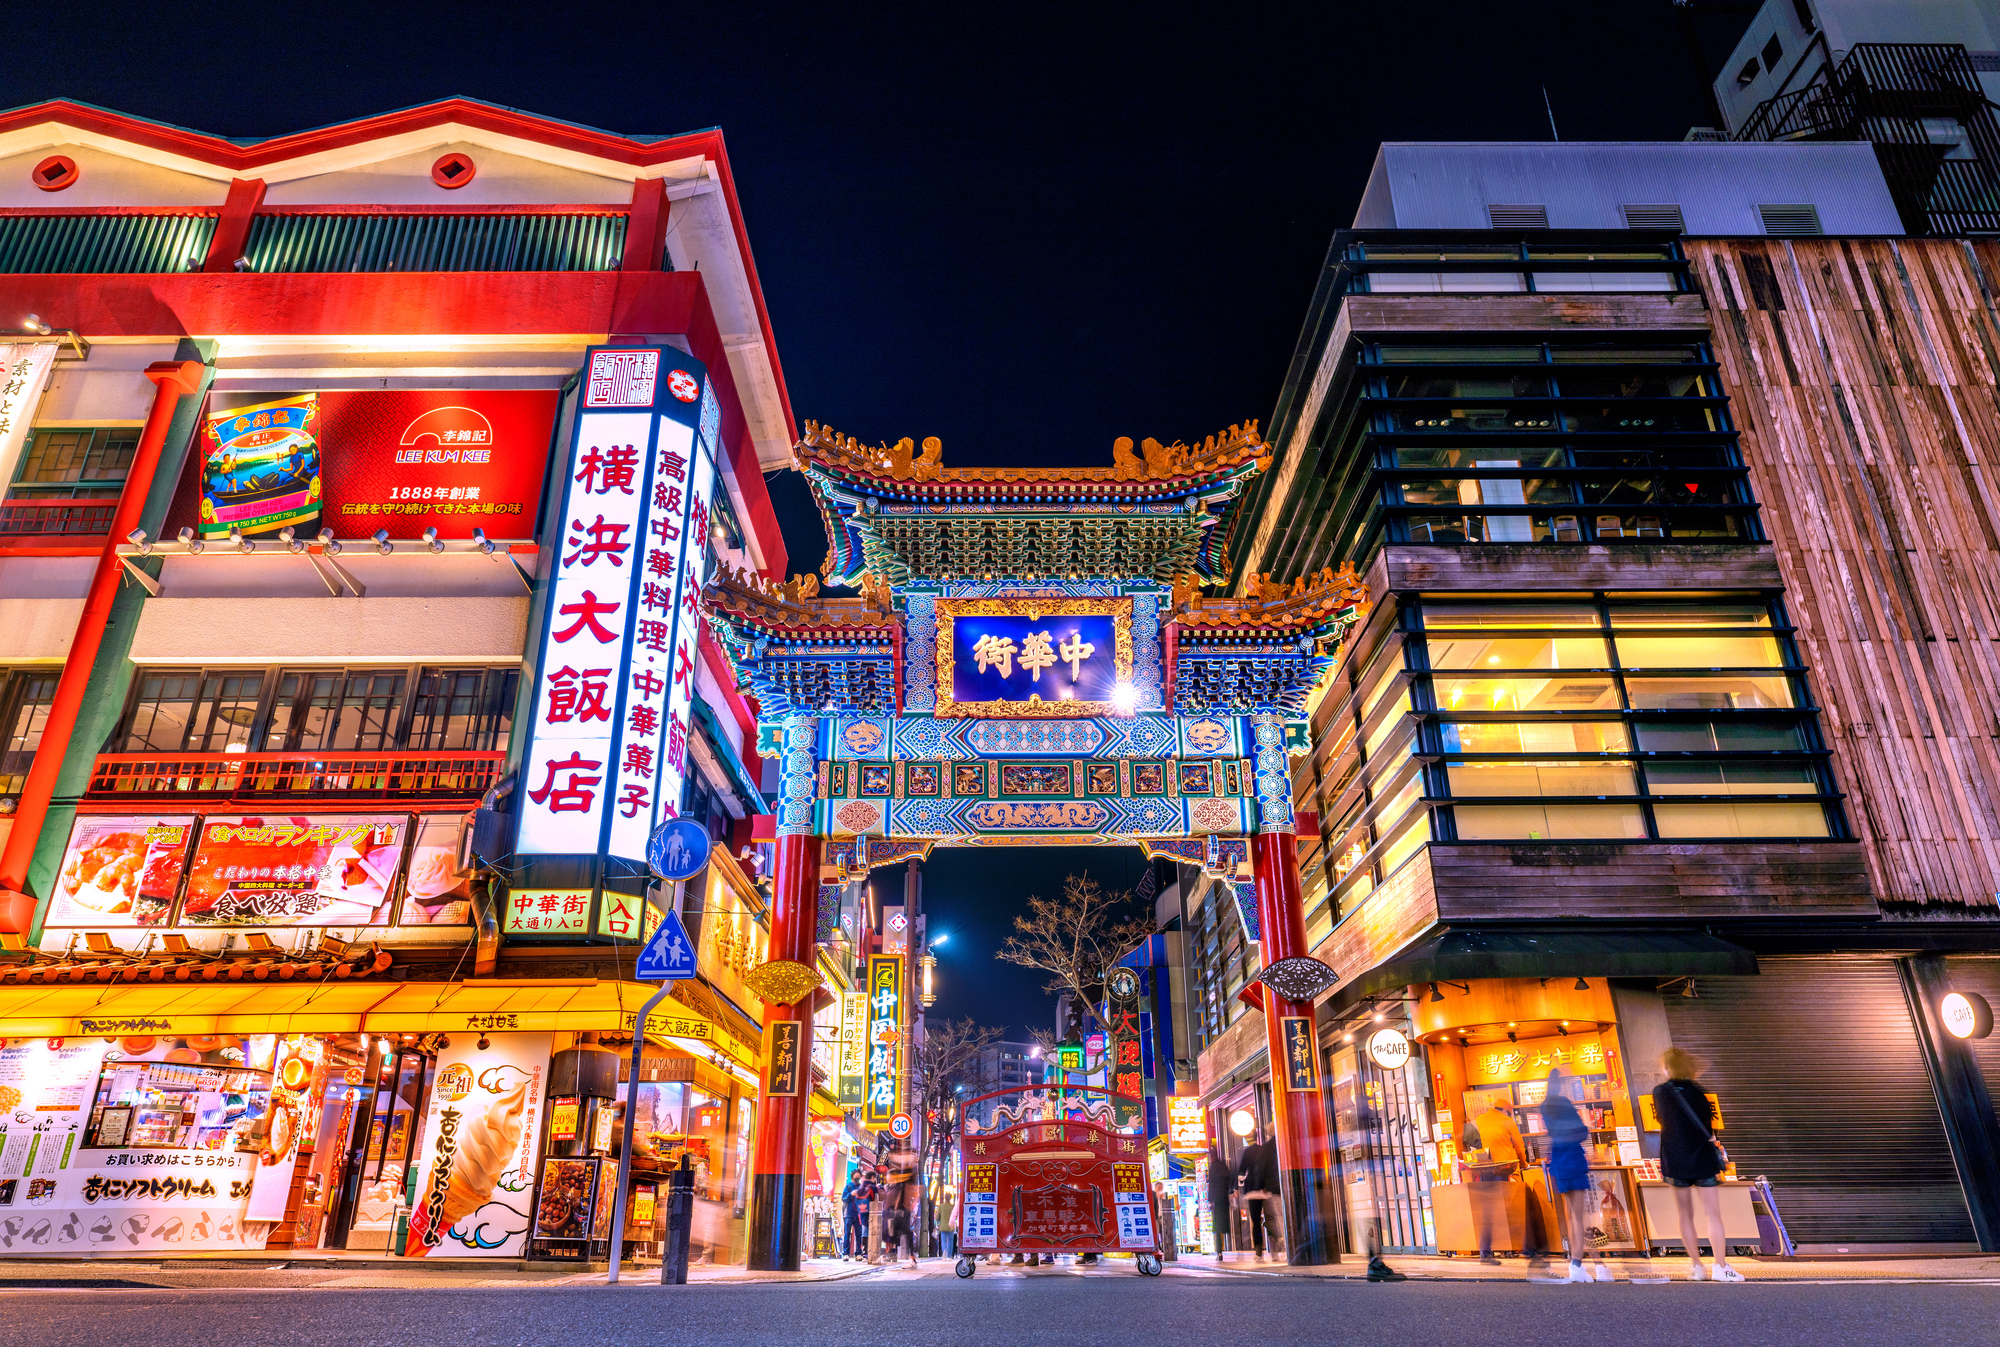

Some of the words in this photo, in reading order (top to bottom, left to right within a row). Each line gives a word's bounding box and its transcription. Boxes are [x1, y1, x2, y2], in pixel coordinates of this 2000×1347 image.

[442, 430, 487, 442] 李錦記
[396, 450, 423, 463] LEE
[425, 450, 458, 463] KUM
[462, 450, 491, 463] KEE
[389, 487, 481, 500] 1888年創業
[223, 511, 250, 521] PREMIUM
[252, 506, 279, 517] OYSTER
[280, 501, 300, 510] SAUCE
[253, 502, 269, 510] KUM
[270, 498, 283, 506] KEE
[341, 502, 522, 516] 伝統を守り続けてきた本場の味
[259, 516, 272, 524] NET
[527, 444, 639, 814] 横浜大飯店
[618, 449, 688, 819] 高級中華料理・中華菓子
[972, 630, 1096, 682] 中華街
[210, 824, 373, 847] 「食べログ」ランキング
[378, 831, 393, 844] 1位
[213, 865, 332, 880] こだわりの本格中華
[213, 891, 320, 917] 食べ放題
[513, 893, 588, 915] 中華街
[509, 915, 585, 931] 大通り入口
[607, 897, 635, 935] 入口
[466, 1014, 519, 1029] 大粒甘栗
[1954, 1007, 1973, 1022] CAFE
[853, 995, 865, 1074] 中国料理世界チャンピオン
[1387, 1043, 1408, 1055] CAFE
[439, 1067, 472, 1093] 元祖
[529, 1065, 541, 1104] 中華街名物
[553, 1113, 576, 1125] 20%
[893, 1119, 908, 1132] 30
[518, 1108, 536, 1181] 横浜大飯店の自信作
[424, 1106, 463, 1247] 杏仁ソフトクリーム
[82, 1174, 216, 1202] 杏仁ソフトクリーム
[636, 1202, 652, 1212] 20%
[1037, 1195, 1078, 1208] 不准
[1024, 1210, 1093, 1223] 車馬駛入
[1027, 1224, 1089, 1232] 加賀町警察署
